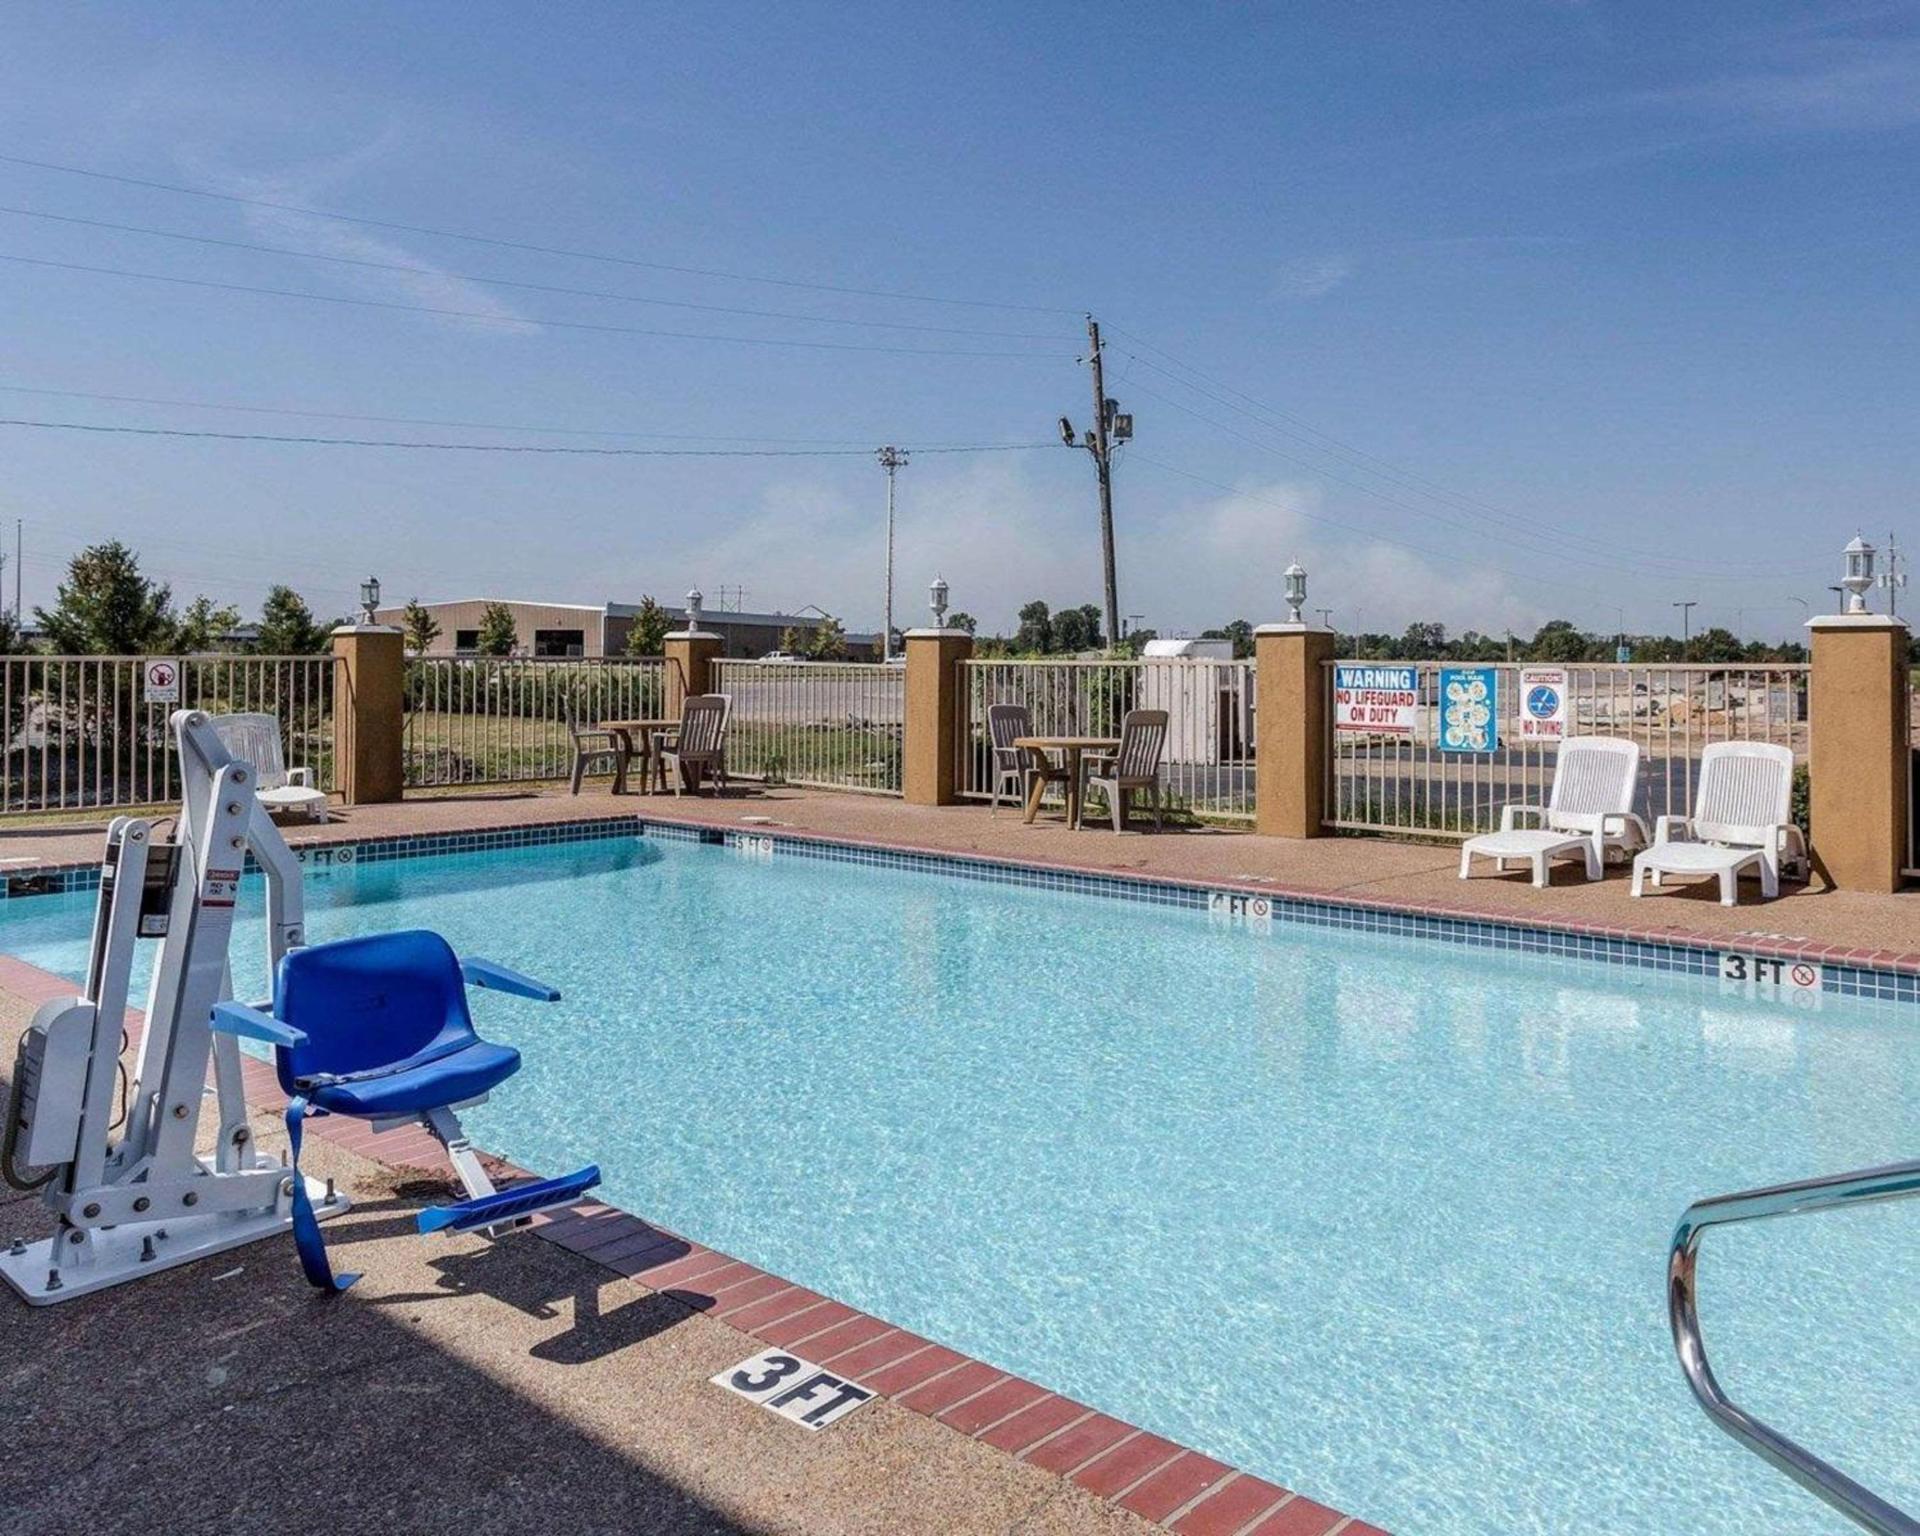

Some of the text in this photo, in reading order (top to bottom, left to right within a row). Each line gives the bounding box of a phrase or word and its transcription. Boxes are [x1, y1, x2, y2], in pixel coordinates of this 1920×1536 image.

[1340, 669, 1411, 688] WARNING
[1336, 690, 1414, 707] NO LIFEGUARD
[1350, 707, 1398, 723] ON DUTY
[1523, 720, 1534, 734] NO
[1230, 895, 1249, 916] FT
[1725, 955, 1785, 985] 3 FT
[731, 1356, 872, 1423] 3 FT
